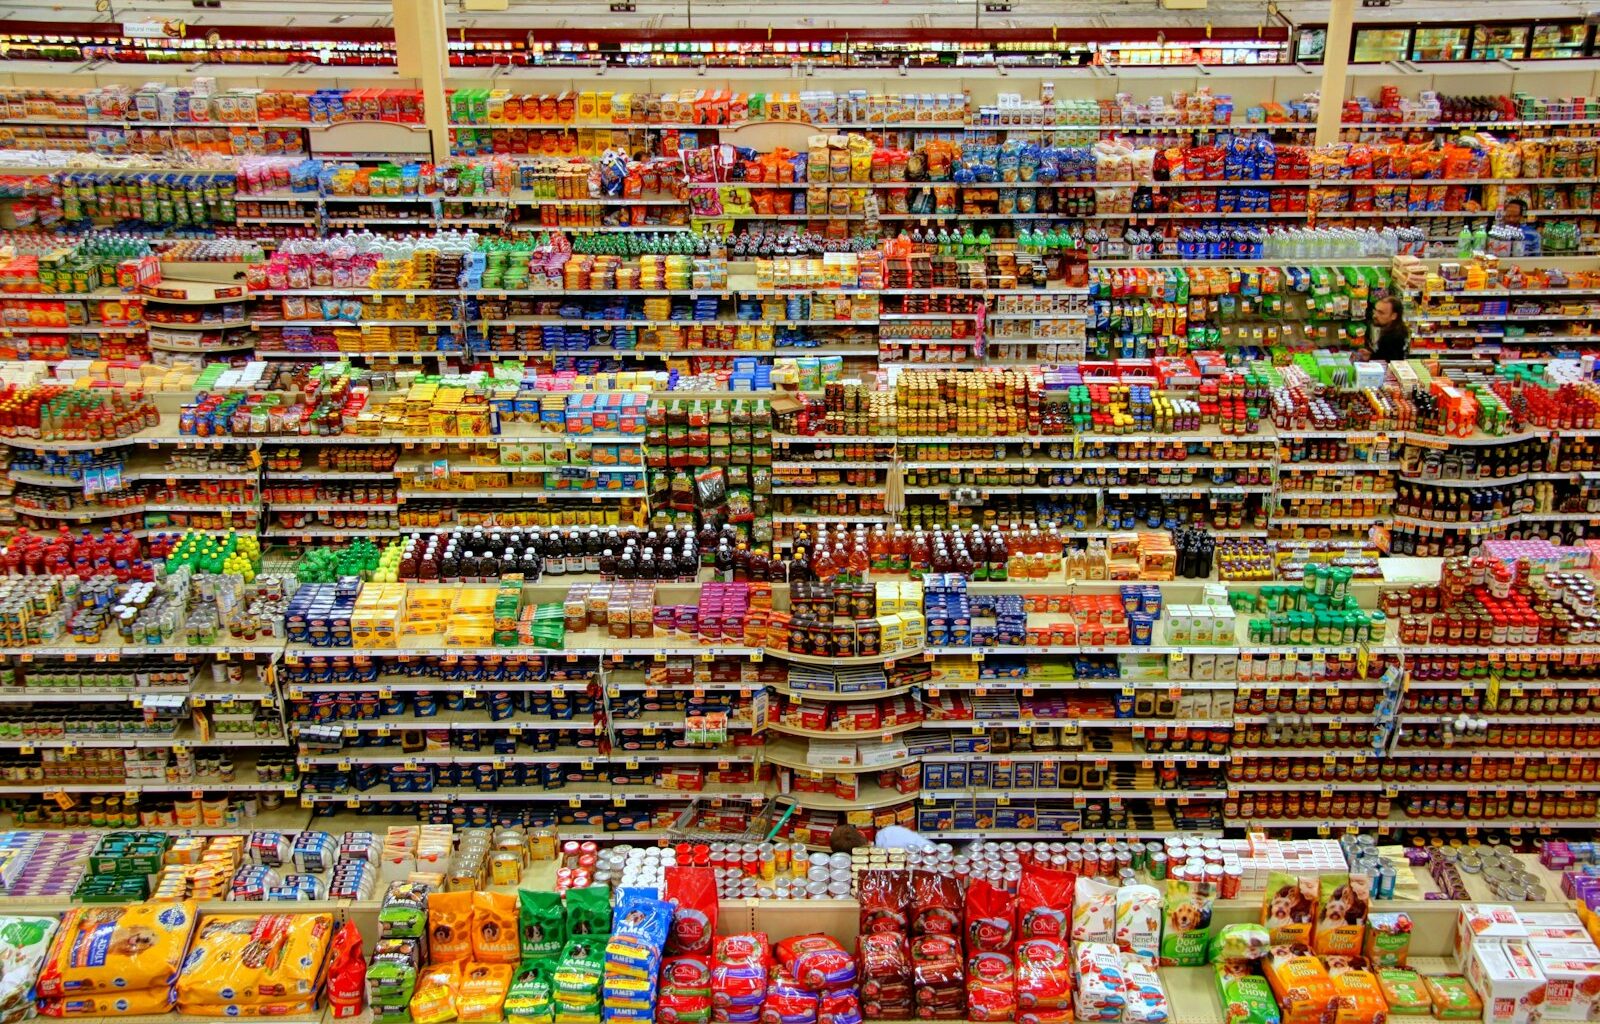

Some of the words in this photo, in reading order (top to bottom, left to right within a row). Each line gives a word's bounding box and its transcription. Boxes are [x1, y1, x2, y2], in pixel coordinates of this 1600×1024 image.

[676, 924, 701, 934] ONE
[872, 924, 895, 934] ONE
[924, 920, 947, 931] ONE
[1033, 920, 1057, 931] ONE
[1329, 934, 1349, 942] DOG
[523, 943, 551, 951] IAMS
[725, 944, 751, 952] ONE
[921, 943, 946, 951] ONE
[1175, 944, 1203, 953] CHOW
[1328, 941, 1355, 949] CHOW
[564, 958, 592, 968] IAMS
[612, 955, 630, 964] IAMS
[978, 960, 1003, 970] ONE
[674, 966, 697, 976] ONE
[1292, 969, 1318, 977] CHOW
[1343, 976, 1360, 984] DOG
[1238, 981, 1254, 990] DOG
[1345, 981, 1372, 989] CHOW
[612, 989, 630, 997] IAMS
[1238, 988, 1268, 997] CHOW
[1548, 987, 1573, 998] MEATY
